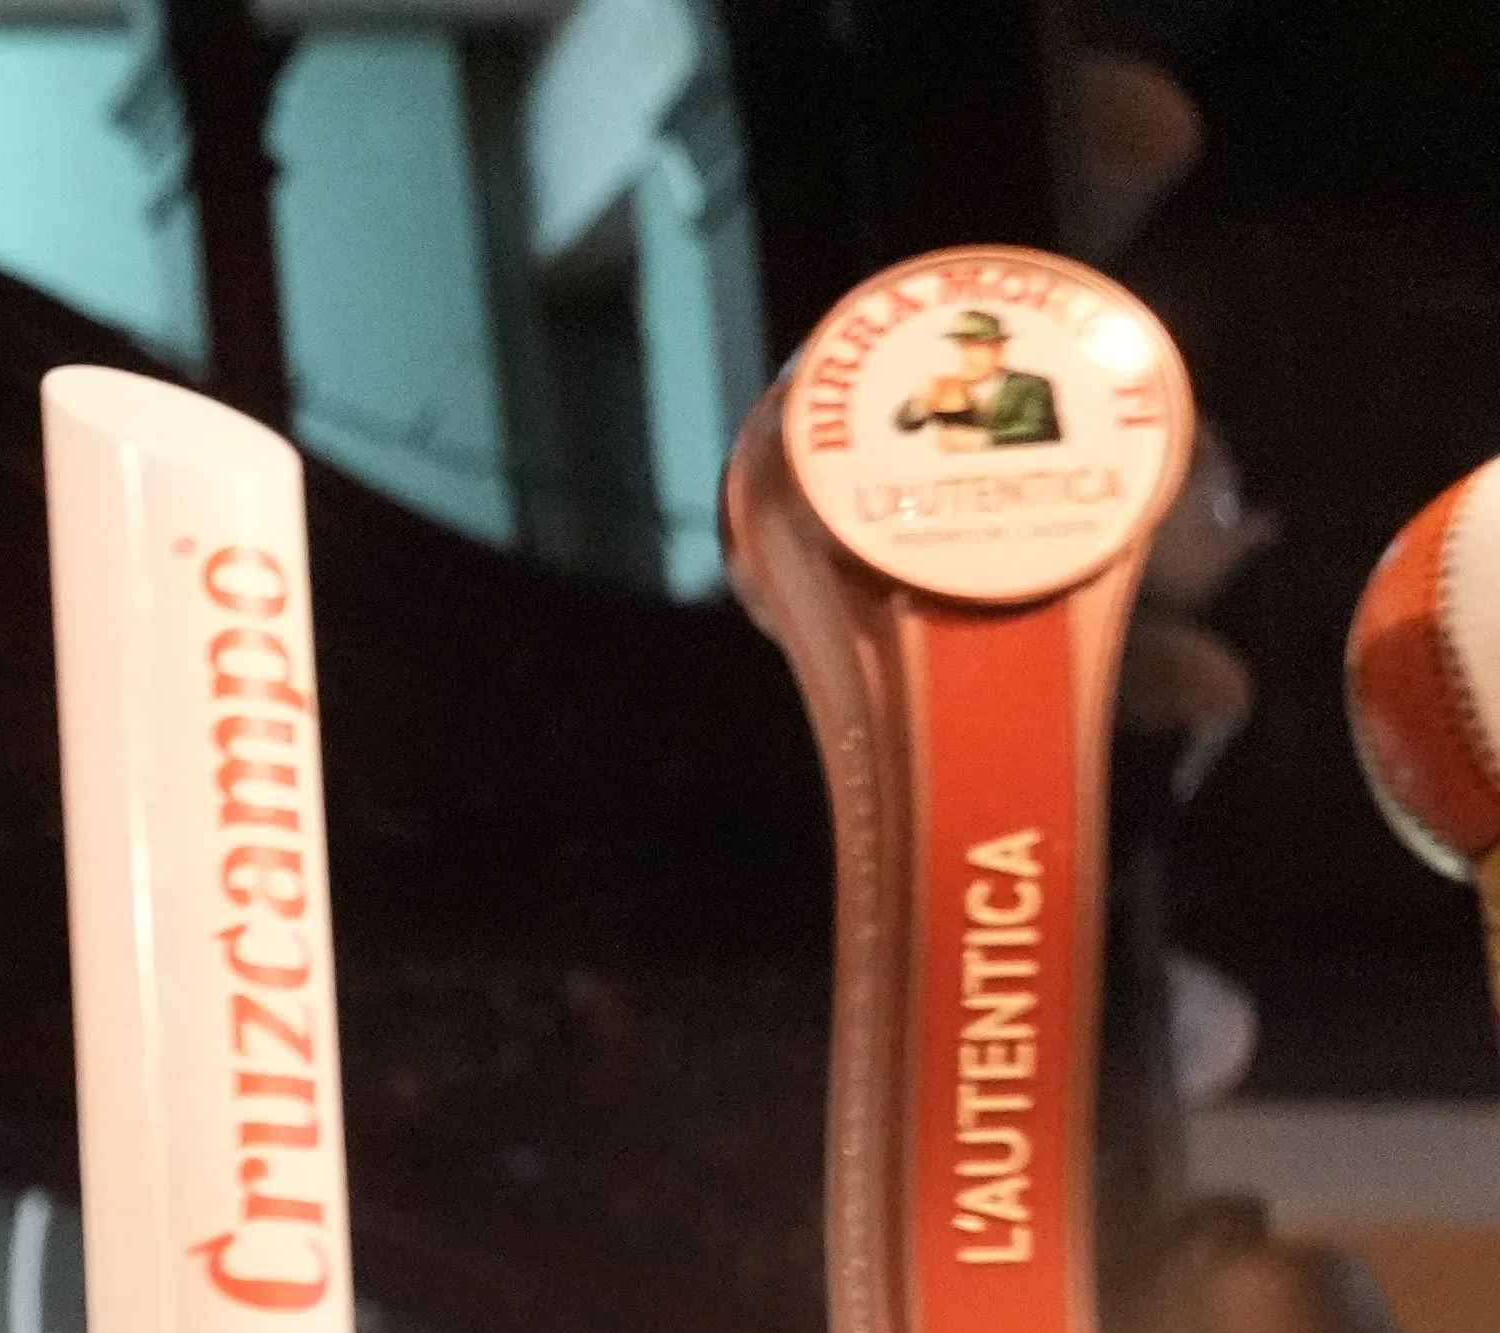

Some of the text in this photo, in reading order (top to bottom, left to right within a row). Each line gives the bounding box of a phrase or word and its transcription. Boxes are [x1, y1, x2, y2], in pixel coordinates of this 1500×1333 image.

[810, 288, 924, 452] BIRRA
[185, 543, 332, 1313] Cruzcampo
[952, 827, 1044, 1264] L'AUTENTICA
